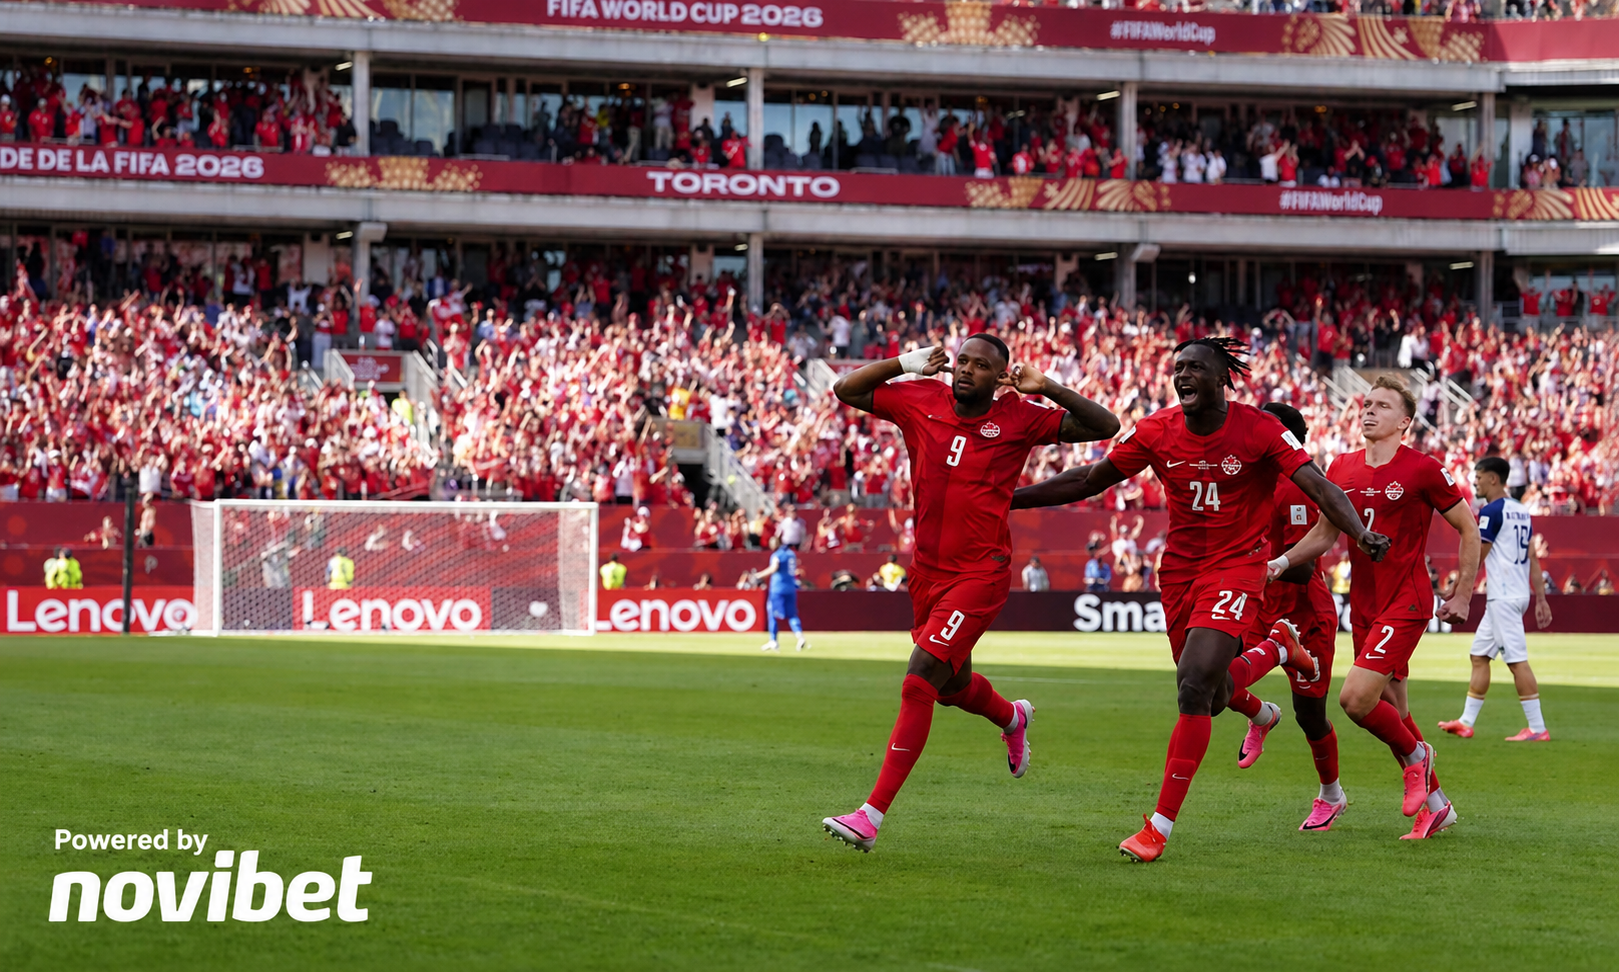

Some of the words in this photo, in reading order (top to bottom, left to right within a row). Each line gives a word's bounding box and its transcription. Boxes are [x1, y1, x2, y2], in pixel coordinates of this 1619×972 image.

[547, 0, 599, 19] FIFA
[601, 0, 687, 22] WORLD
[690, 5, 739, 24] CUP
[740, 7, 824, 27] 2026
[1110, 20, 1216, 46] #FIFAWorldCup
[0, 147, 33, 170] DE
[38, 149, 71, 171] DE
[76, 150, 110, 173] LA
[114, 151, 170, 175] FIFA
[175, 154, 264, 179] 2026
[647, 171, 840, 197] TORONTO
[1279, 190, 1383, 215] #FIFAWorldCup
[946, 435, 967, 467] 9
[1189, 481, 1221, 512] 24
[6, 589, 199, 633] Lenovo
[302, 590, 482, 632] Lenovo
[1073, 593, 1168, 632] Sma
[1211, 590, 1248, 621] 24
[940, 610, 965, 641] 9
[1374, 625, 1394, 655] 2
